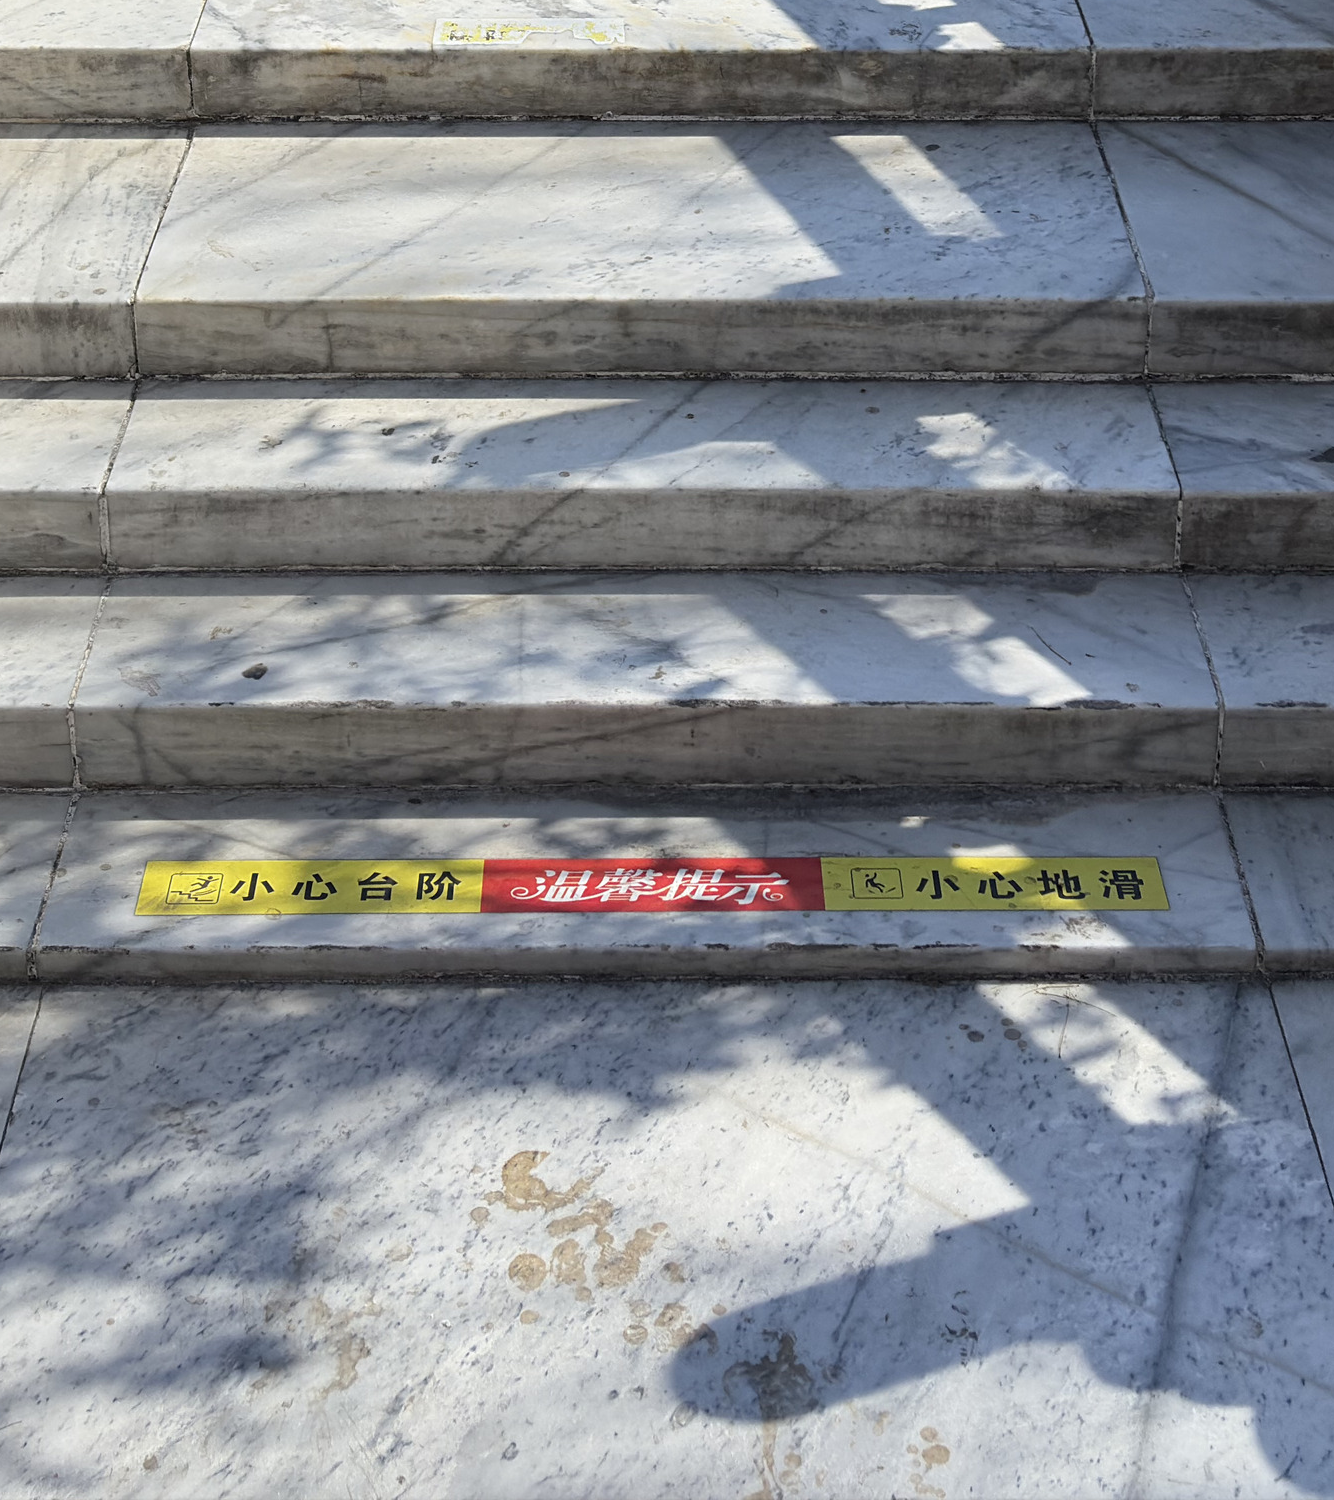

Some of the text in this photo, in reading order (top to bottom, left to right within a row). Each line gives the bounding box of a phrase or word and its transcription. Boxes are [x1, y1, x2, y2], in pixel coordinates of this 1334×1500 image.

[230, 868, 1145, 905] 小心台阶 温馨提示 小心地滑
